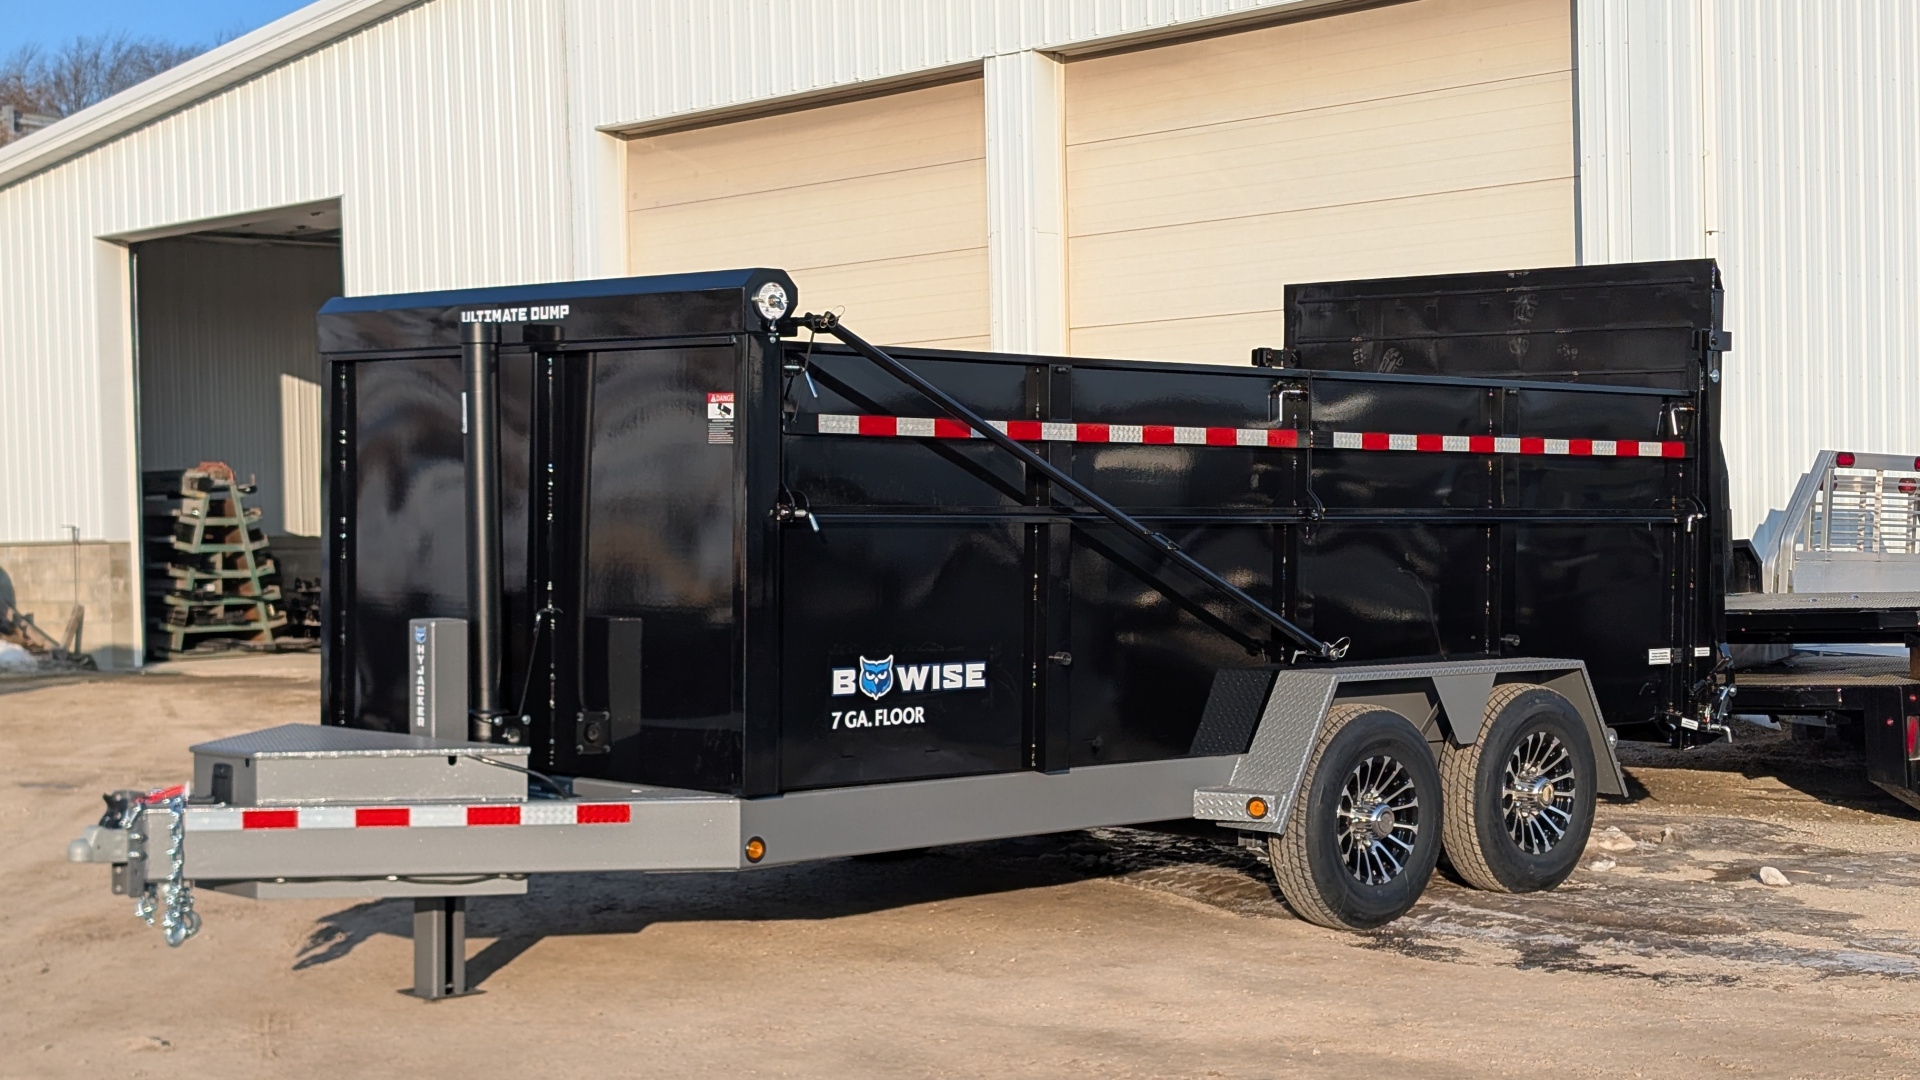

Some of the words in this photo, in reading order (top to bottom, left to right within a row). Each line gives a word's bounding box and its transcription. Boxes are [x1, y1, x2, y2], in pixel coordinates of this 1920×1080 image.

[461, 308, 528, 323] ULTIMATE
[530, 305, 570, 320] DUMP
[715, 394, 734, 402] DANGE
[416, 644, 425, 728] HYJACKER
[831, 711, 843, 730] 7
[844, 710, 873, 729] GA.
[875, 706, 926, 727] FLOOR
